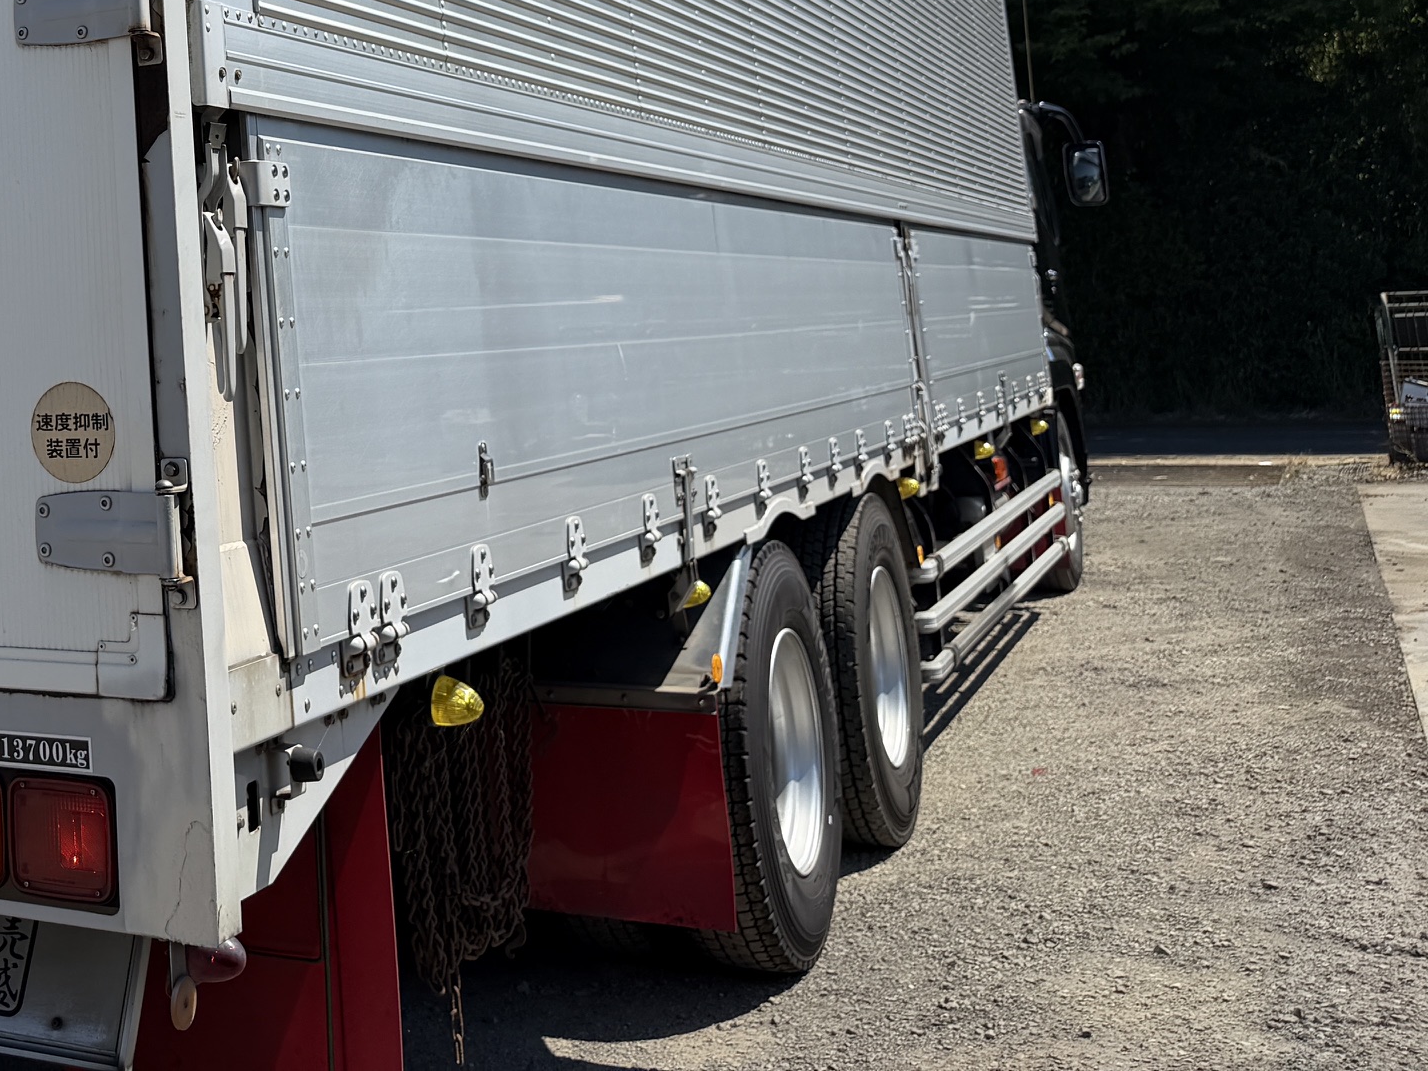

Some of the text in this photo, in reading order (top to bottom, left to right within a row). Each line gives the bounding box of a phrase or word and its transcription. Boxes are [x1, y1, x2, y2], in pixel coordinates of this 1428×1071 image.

[36, 413, 109, 431] 速度抑制
[47, 438, 100, 458] 装置付
[1, 737, 87, 767] 13700kg
